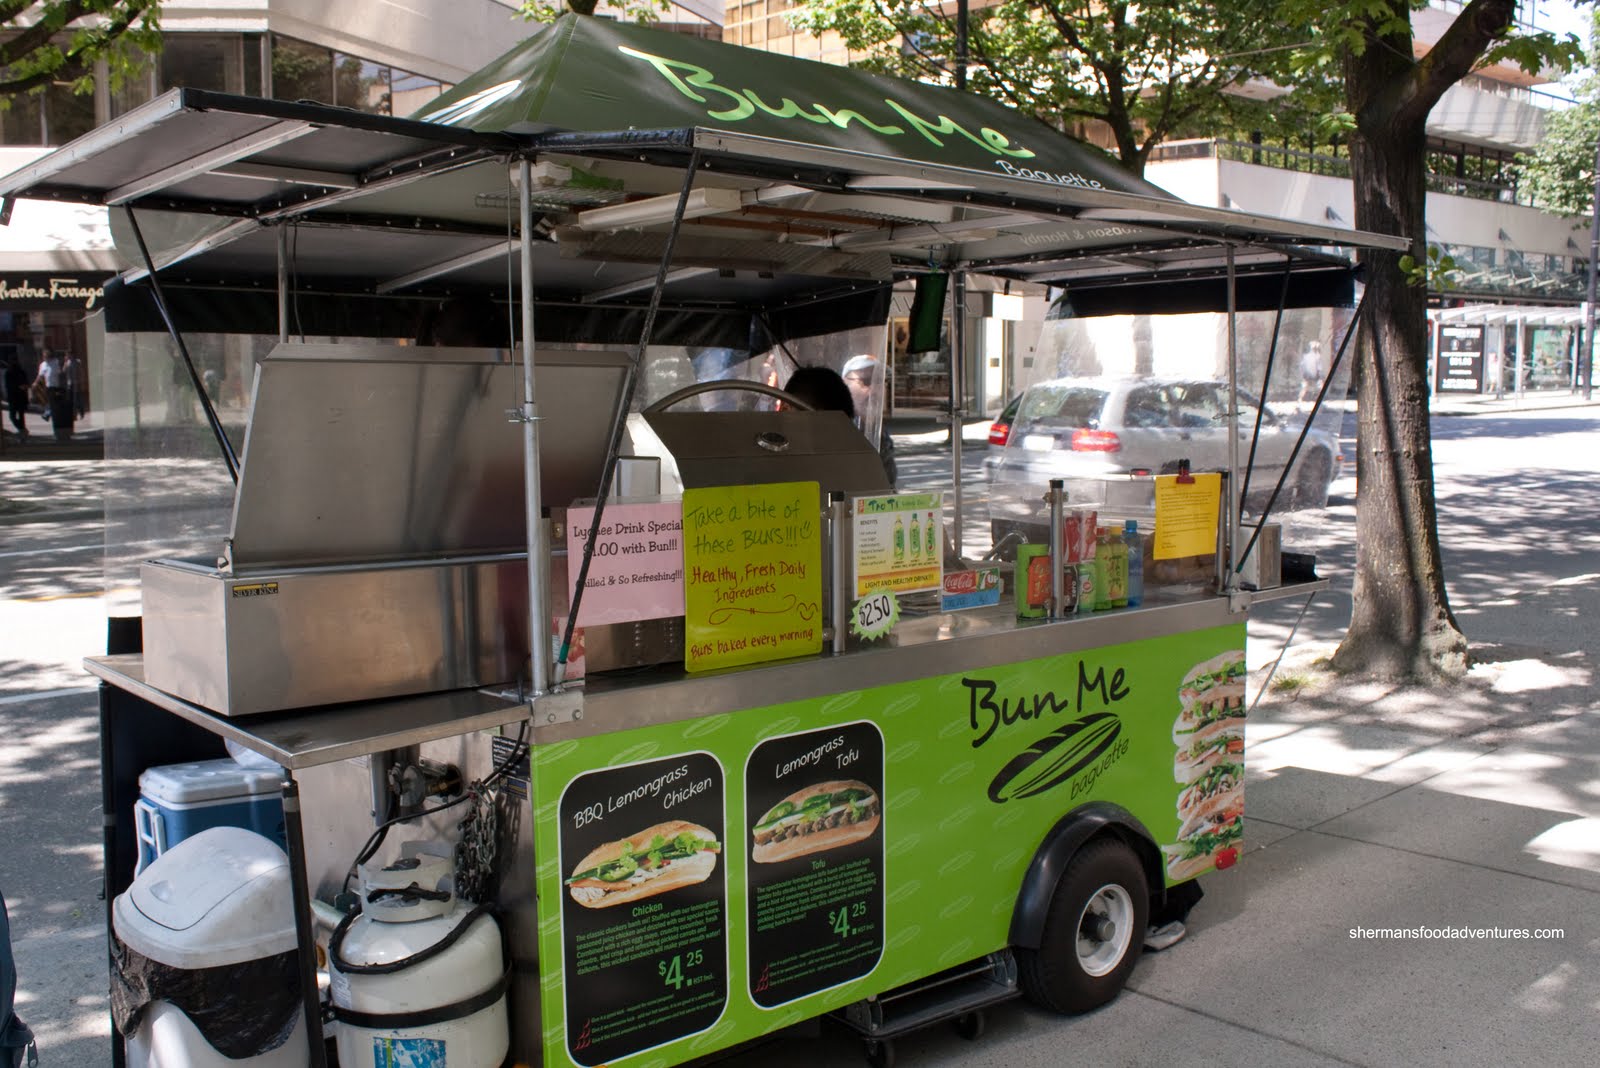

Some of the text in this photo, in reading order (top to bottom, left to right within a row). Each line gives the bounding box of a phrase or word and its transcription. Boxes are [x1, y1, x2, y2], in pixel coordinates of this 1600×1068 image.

[618, 45, 1036, 158] Bun Me
[687, 499, 800, 529] Take a bite of
[615, 522, 645, 535] Drink
[647, 520, 684, 535] Special
[622, 542, 646, 555] with
[648, 539, 678, 552] Bun!!!
[694, 534, 735, 555] these
[607, 575, 616, 586] &
[618, 575, 630, 585] So
[631, 570, 683, 583] Refreshing!!!
[745, 563, 775, 580] Fresh
[779, 561, 806, 579] Daily
[714, 582, 776, 603] Ingredients
[691, 628, 813, 659] Buns baked every morning
[961, 660, 1131, 749] Bun Me
[775, 735, 844, 779] Lemongrass
[836, 748, 859, 769] Tofu
[1070, 738, 1130, 800] baguette
[573, 764, 688, 829] BBQ Lemongrass
[663, 777, 712, 809] Chicken
[812, 860, 826, 870] Tofu
[632, 902, 663, 917] Chicken
